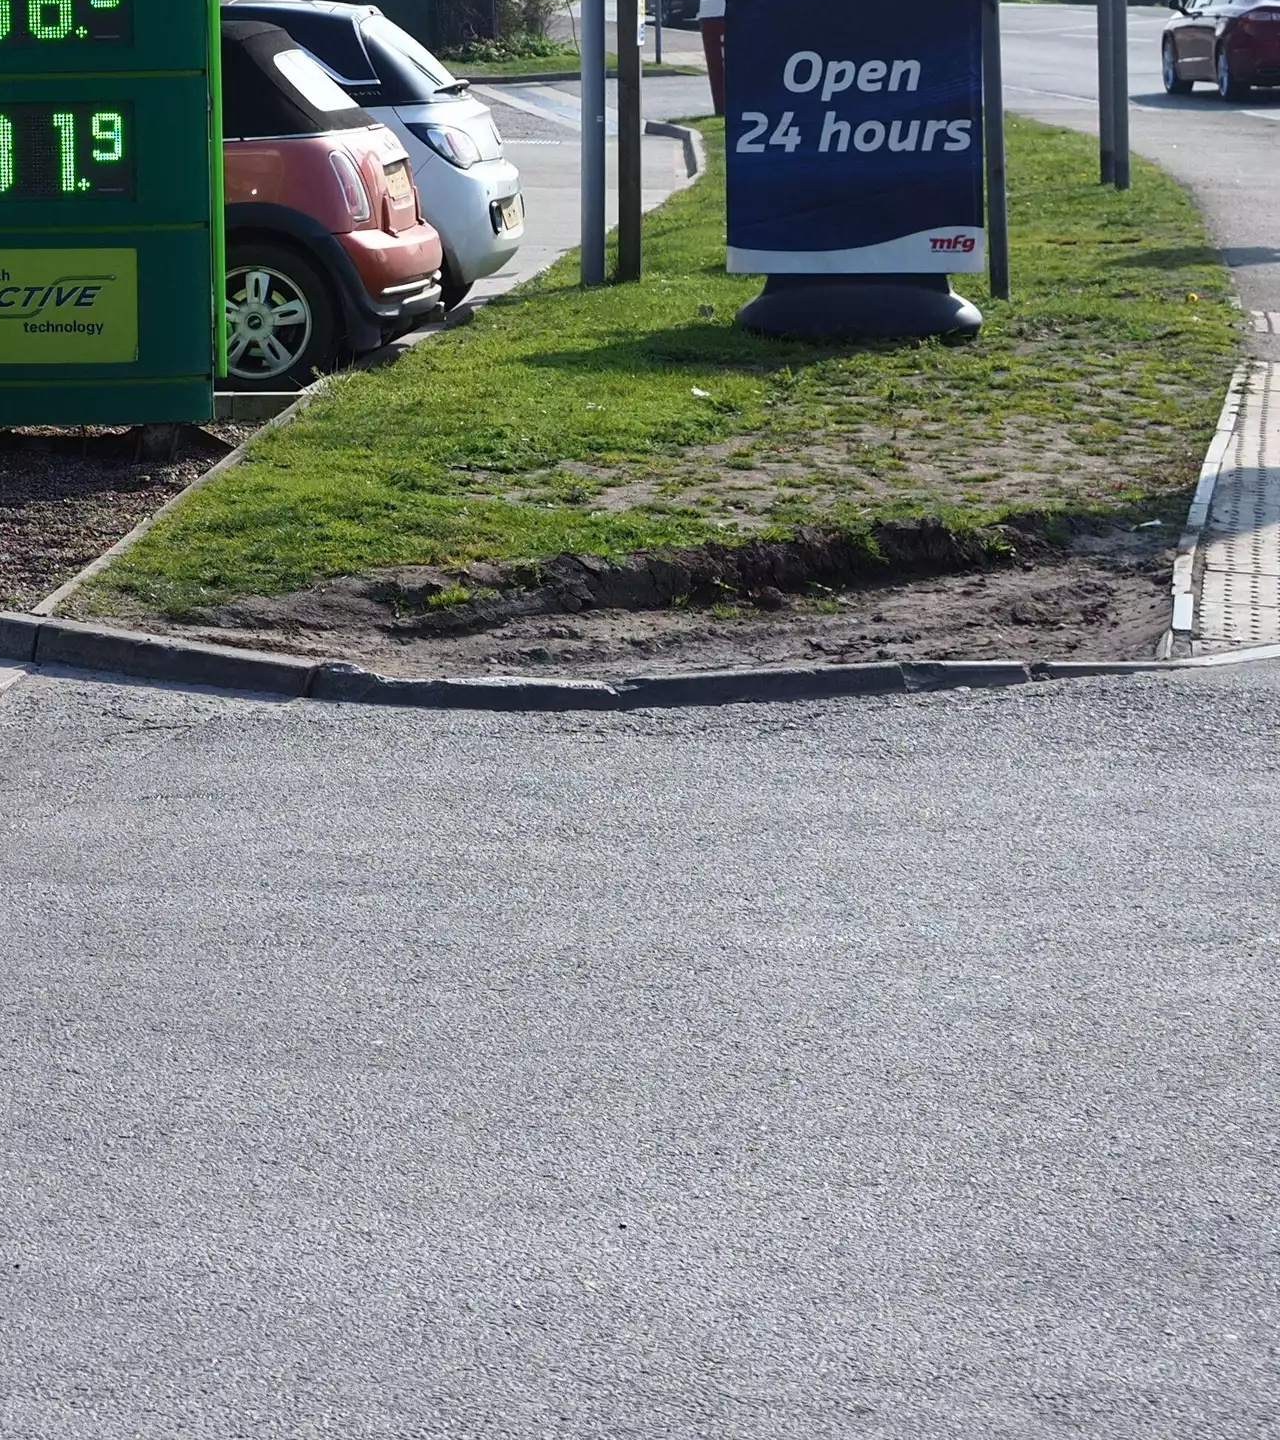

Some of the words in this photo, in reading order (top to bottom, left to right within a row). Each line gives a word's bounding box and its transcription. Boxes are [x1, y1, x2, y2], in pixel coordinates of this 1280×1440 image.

[783, 50, 921, 102] Open
[736, 111, 801, 153] 24
[818, 110, 972, 153] hours
[929, 234, 976, 253] mfg
[23, 320, 104, 335] technology
